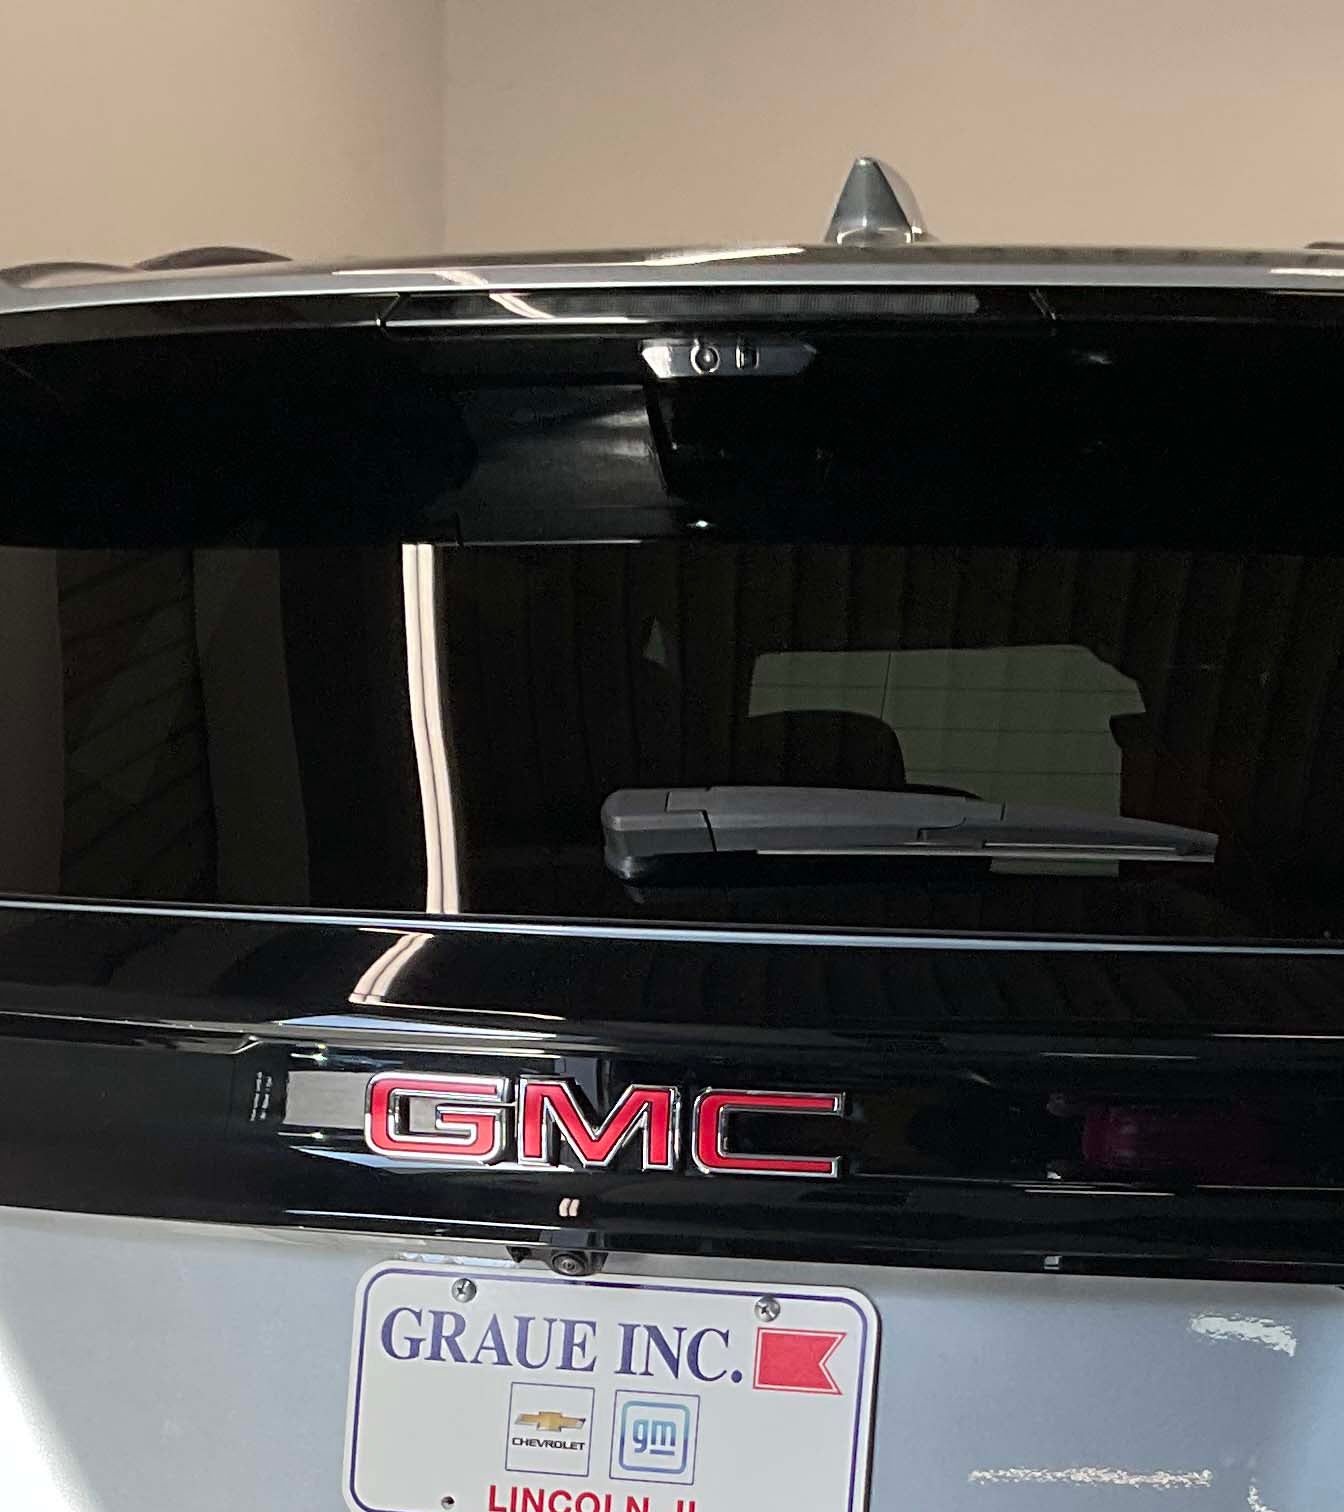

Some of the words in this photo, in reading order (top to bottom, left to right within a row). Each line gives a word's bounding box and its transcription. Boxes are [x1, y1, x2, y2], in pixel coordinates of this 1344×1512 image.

[364, 1071, 845, 1178] GMC
[381, 1306, 598, 1372] GRAUE
[614, 1323, 744, 1383] INC.
[511, 1436, 586, 1452] CHEVROLET
[632, 1420, 677, 1456] gm
